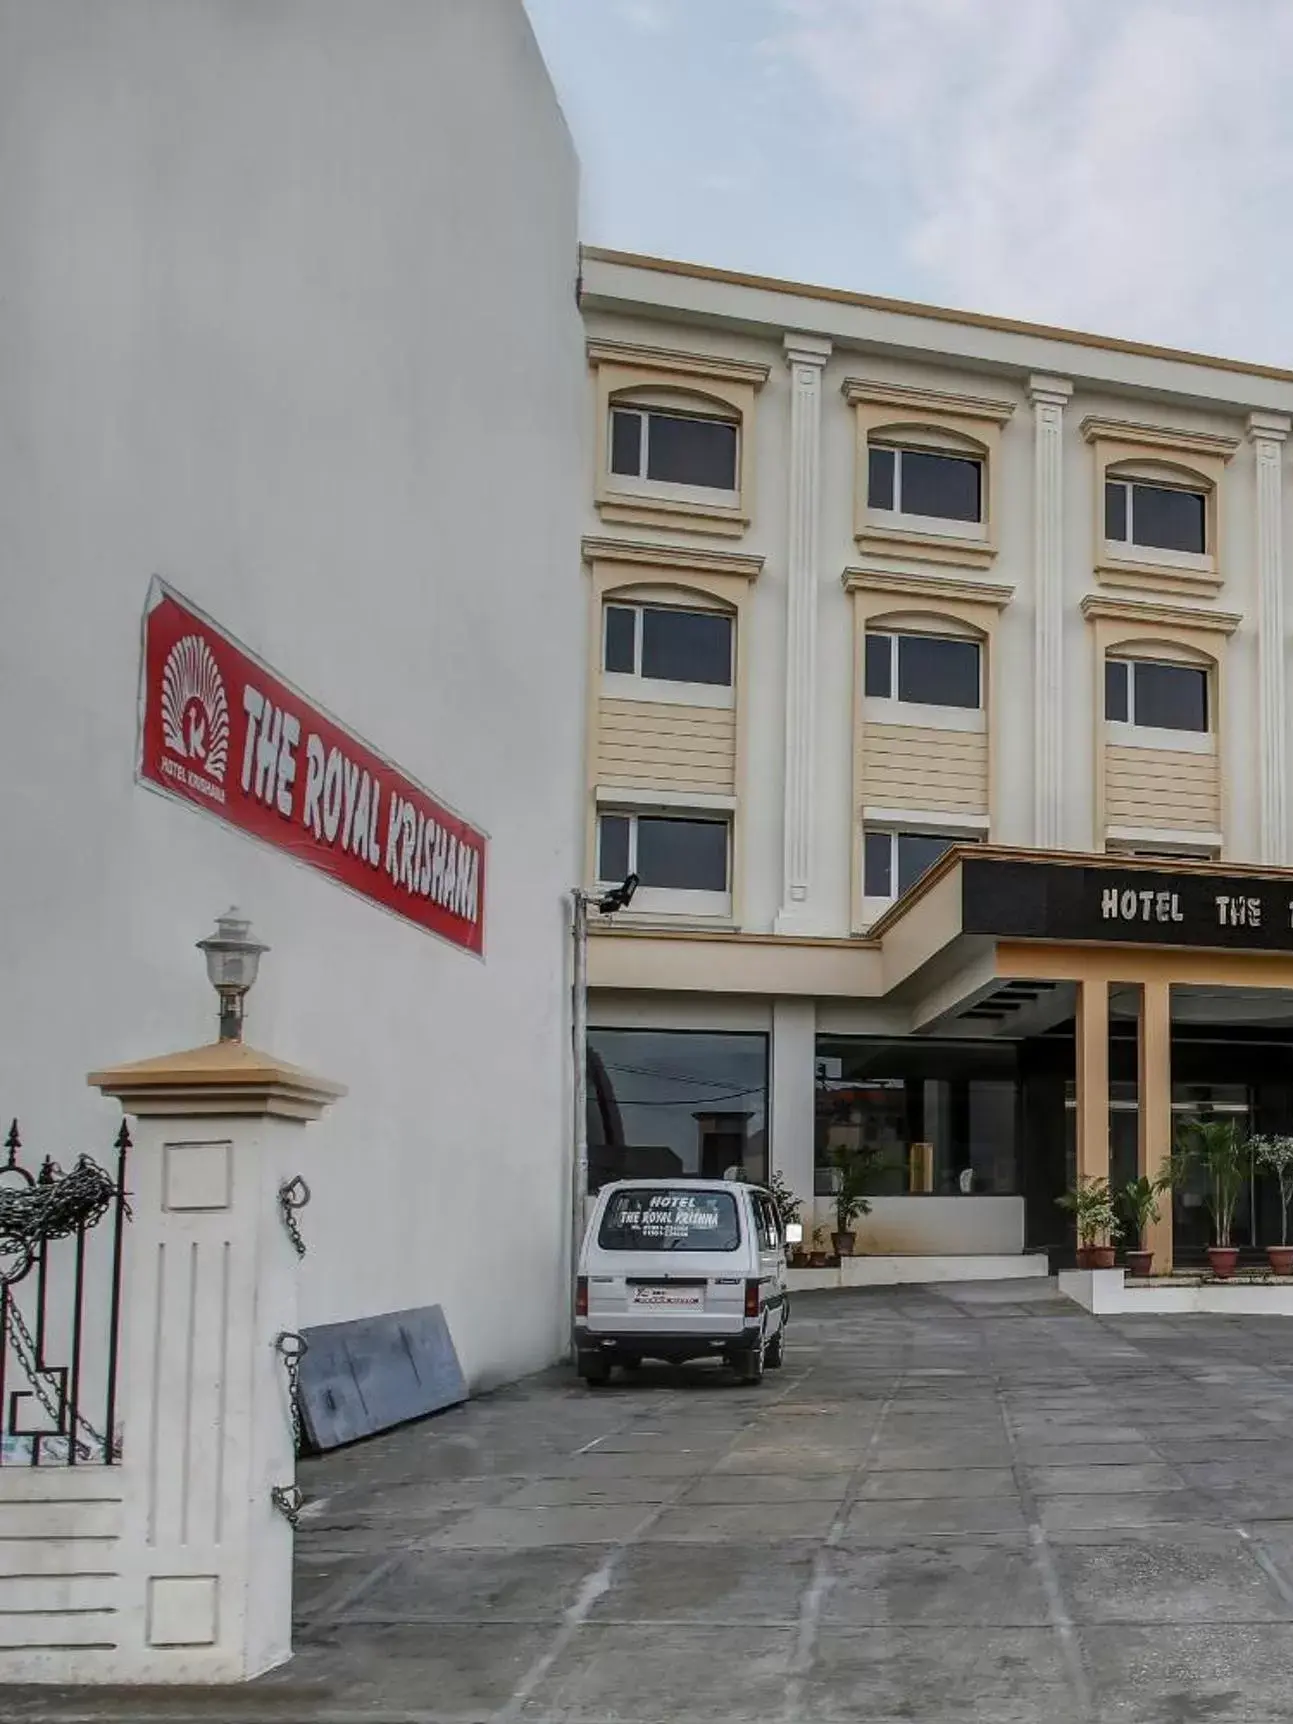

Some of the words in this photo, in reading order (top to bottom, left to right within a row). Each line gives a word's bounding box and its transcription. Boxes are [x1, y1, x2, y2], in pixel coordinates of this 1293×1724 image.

[241, 684, 301, 817] THE
[304, 734, 381, 867] ROYAL
[1101, 889, 1184, 922] HOTEL
[1216, 896, 1262, 927] THE
[650, 1196, 696, 1208] HOTEL
[620, 1211, 639, 1224] THE
[642, 1211, 672, 1224] ROYAL
